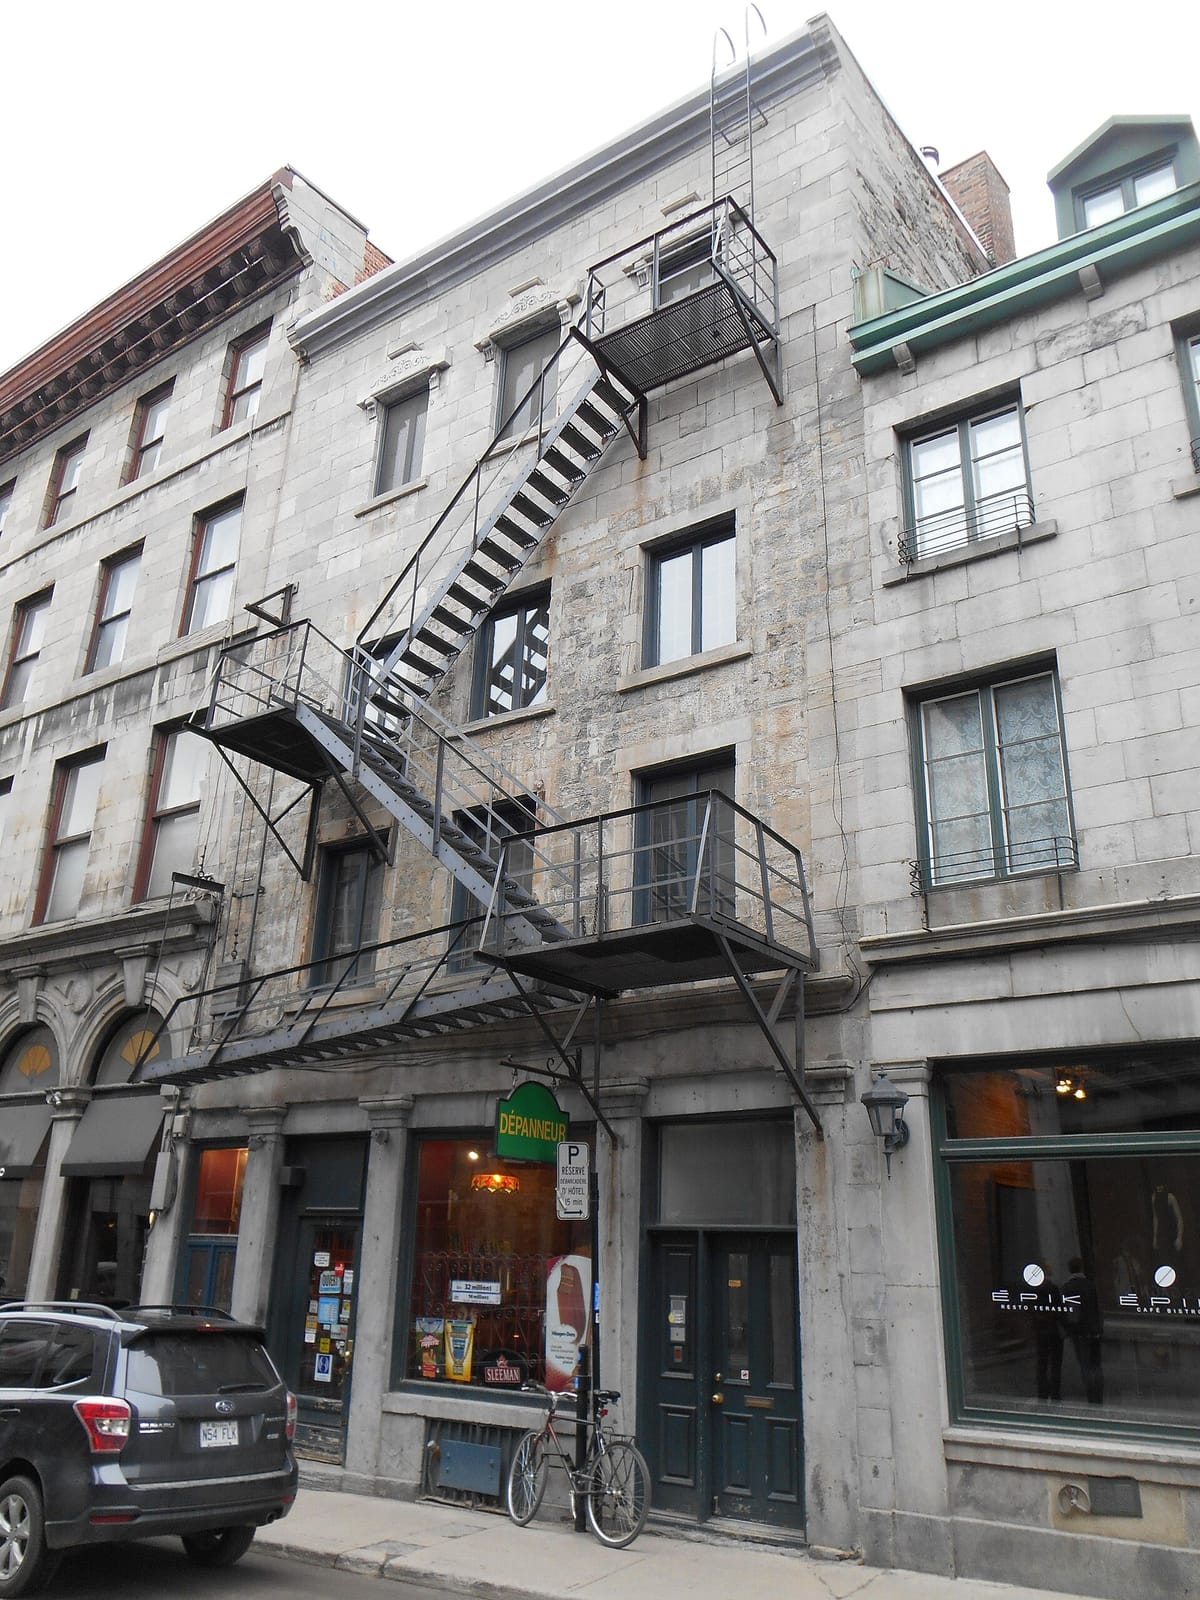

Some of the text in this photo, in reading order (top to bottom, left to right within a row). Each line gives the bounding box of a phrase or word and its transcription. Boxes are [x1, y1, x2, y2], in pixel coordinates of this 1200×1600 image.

[500, 1110, 566, 1142] DÉPANNEUR
[568, 1146, 579, 1165] P
[991, 1289, 1081, 1304] ÉPIK
[1119, 1293, 1200, 1308] ÉPI
[486, 1369, 519, 1381] SLEEMAN
